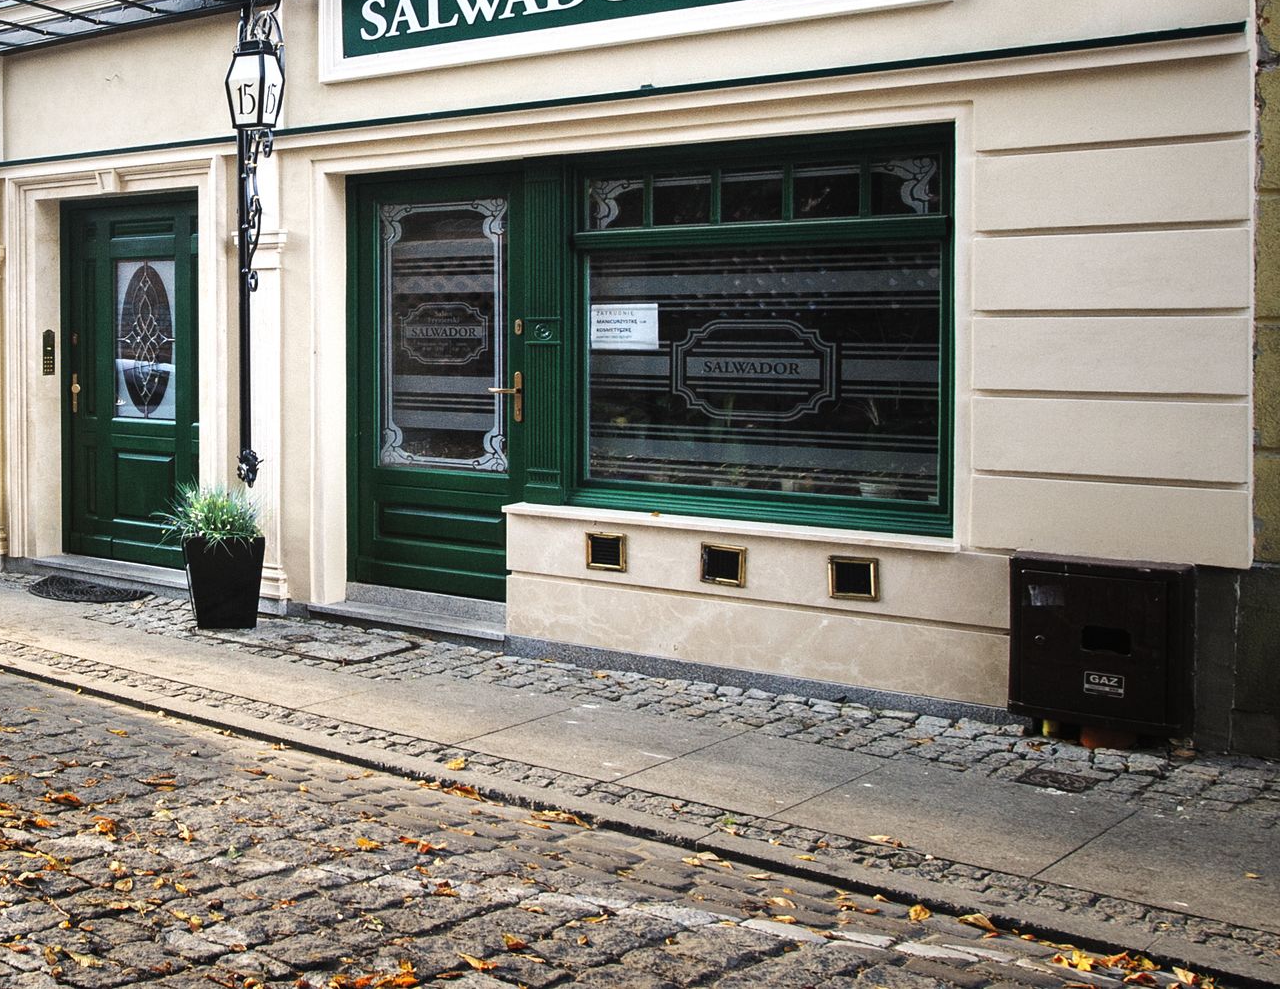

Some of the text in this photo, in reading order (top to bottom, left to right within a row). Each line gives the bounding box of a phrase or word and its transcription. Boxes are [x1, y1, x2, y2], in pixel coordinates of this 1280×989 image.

[237, 83, 256, 115] 15
[265, 83, 278, 114] 15
[412, 327, 477, 337] SALWADOR
[703, 361, 800, 375] SALWADOR
[1089, 674, 1119, 686] GAZ
